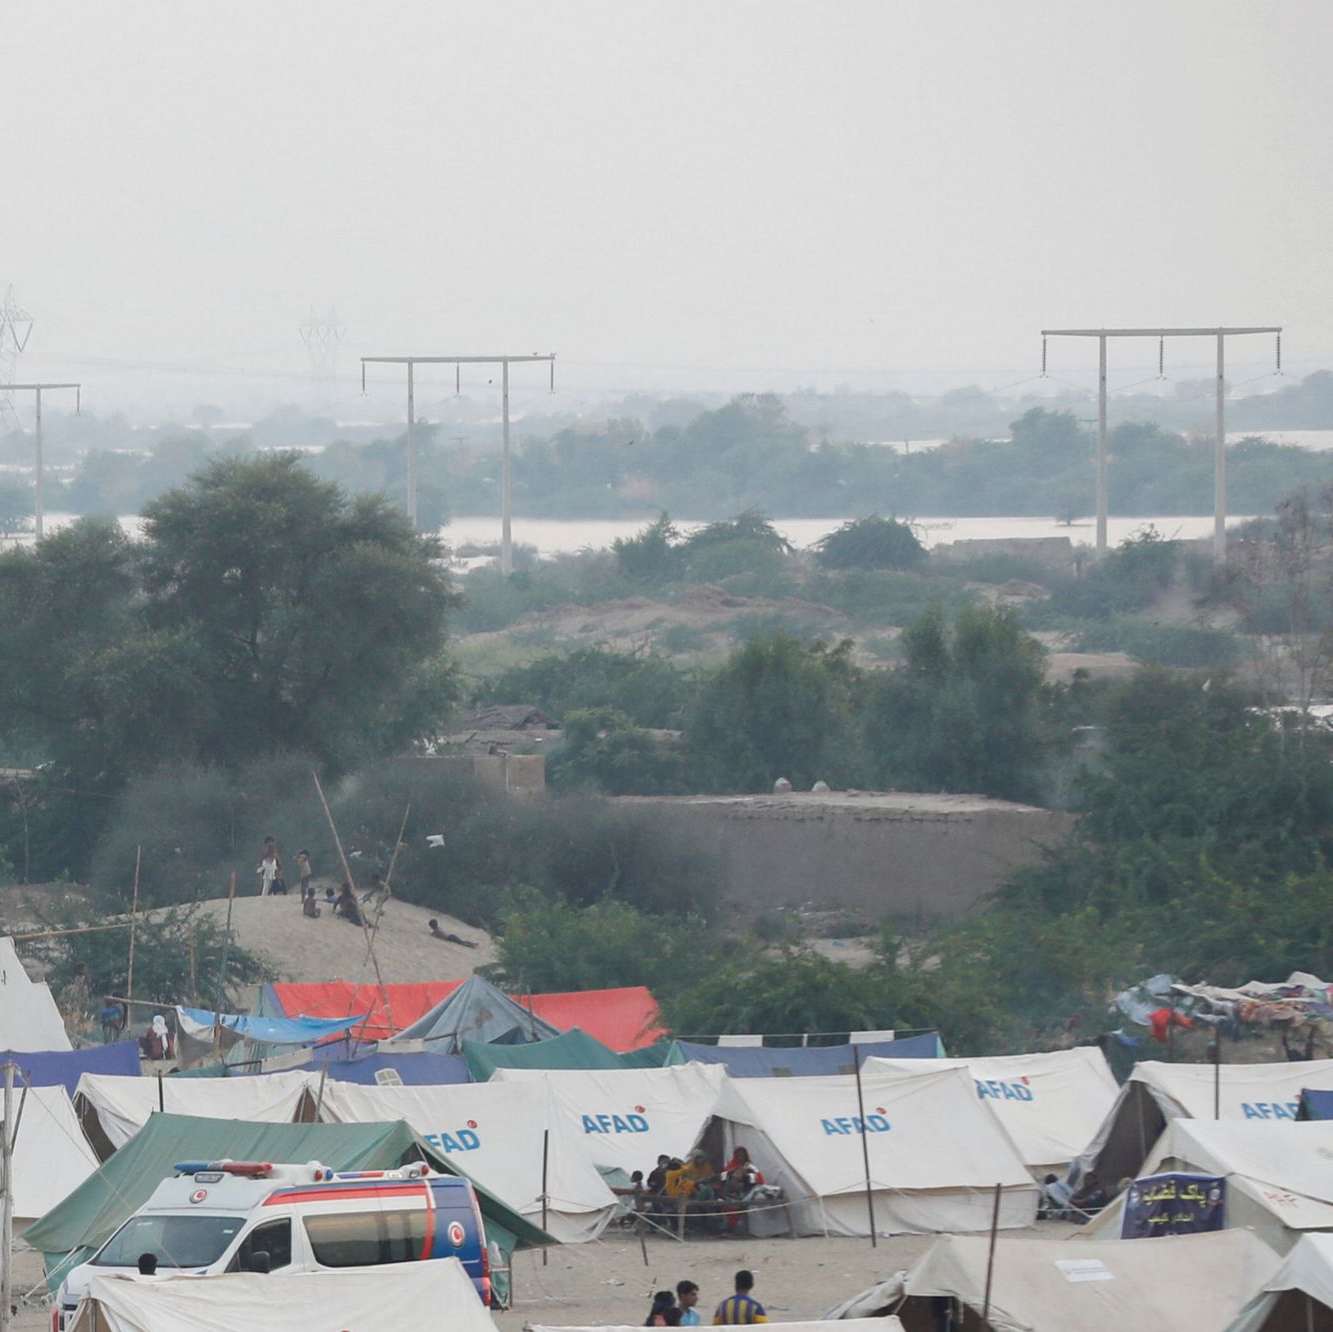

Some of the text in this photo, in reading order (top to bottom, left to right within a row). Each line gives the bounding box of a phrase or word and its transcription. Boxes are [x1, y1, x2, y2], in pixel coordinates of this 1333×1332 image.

[974, 1080, 1034, 1102] AFAD
[582, 1114, 649, 1133] AFAD
[821, 1115, 891, 1135] AFAD
[424, 1129, 480, 1153] FAD
